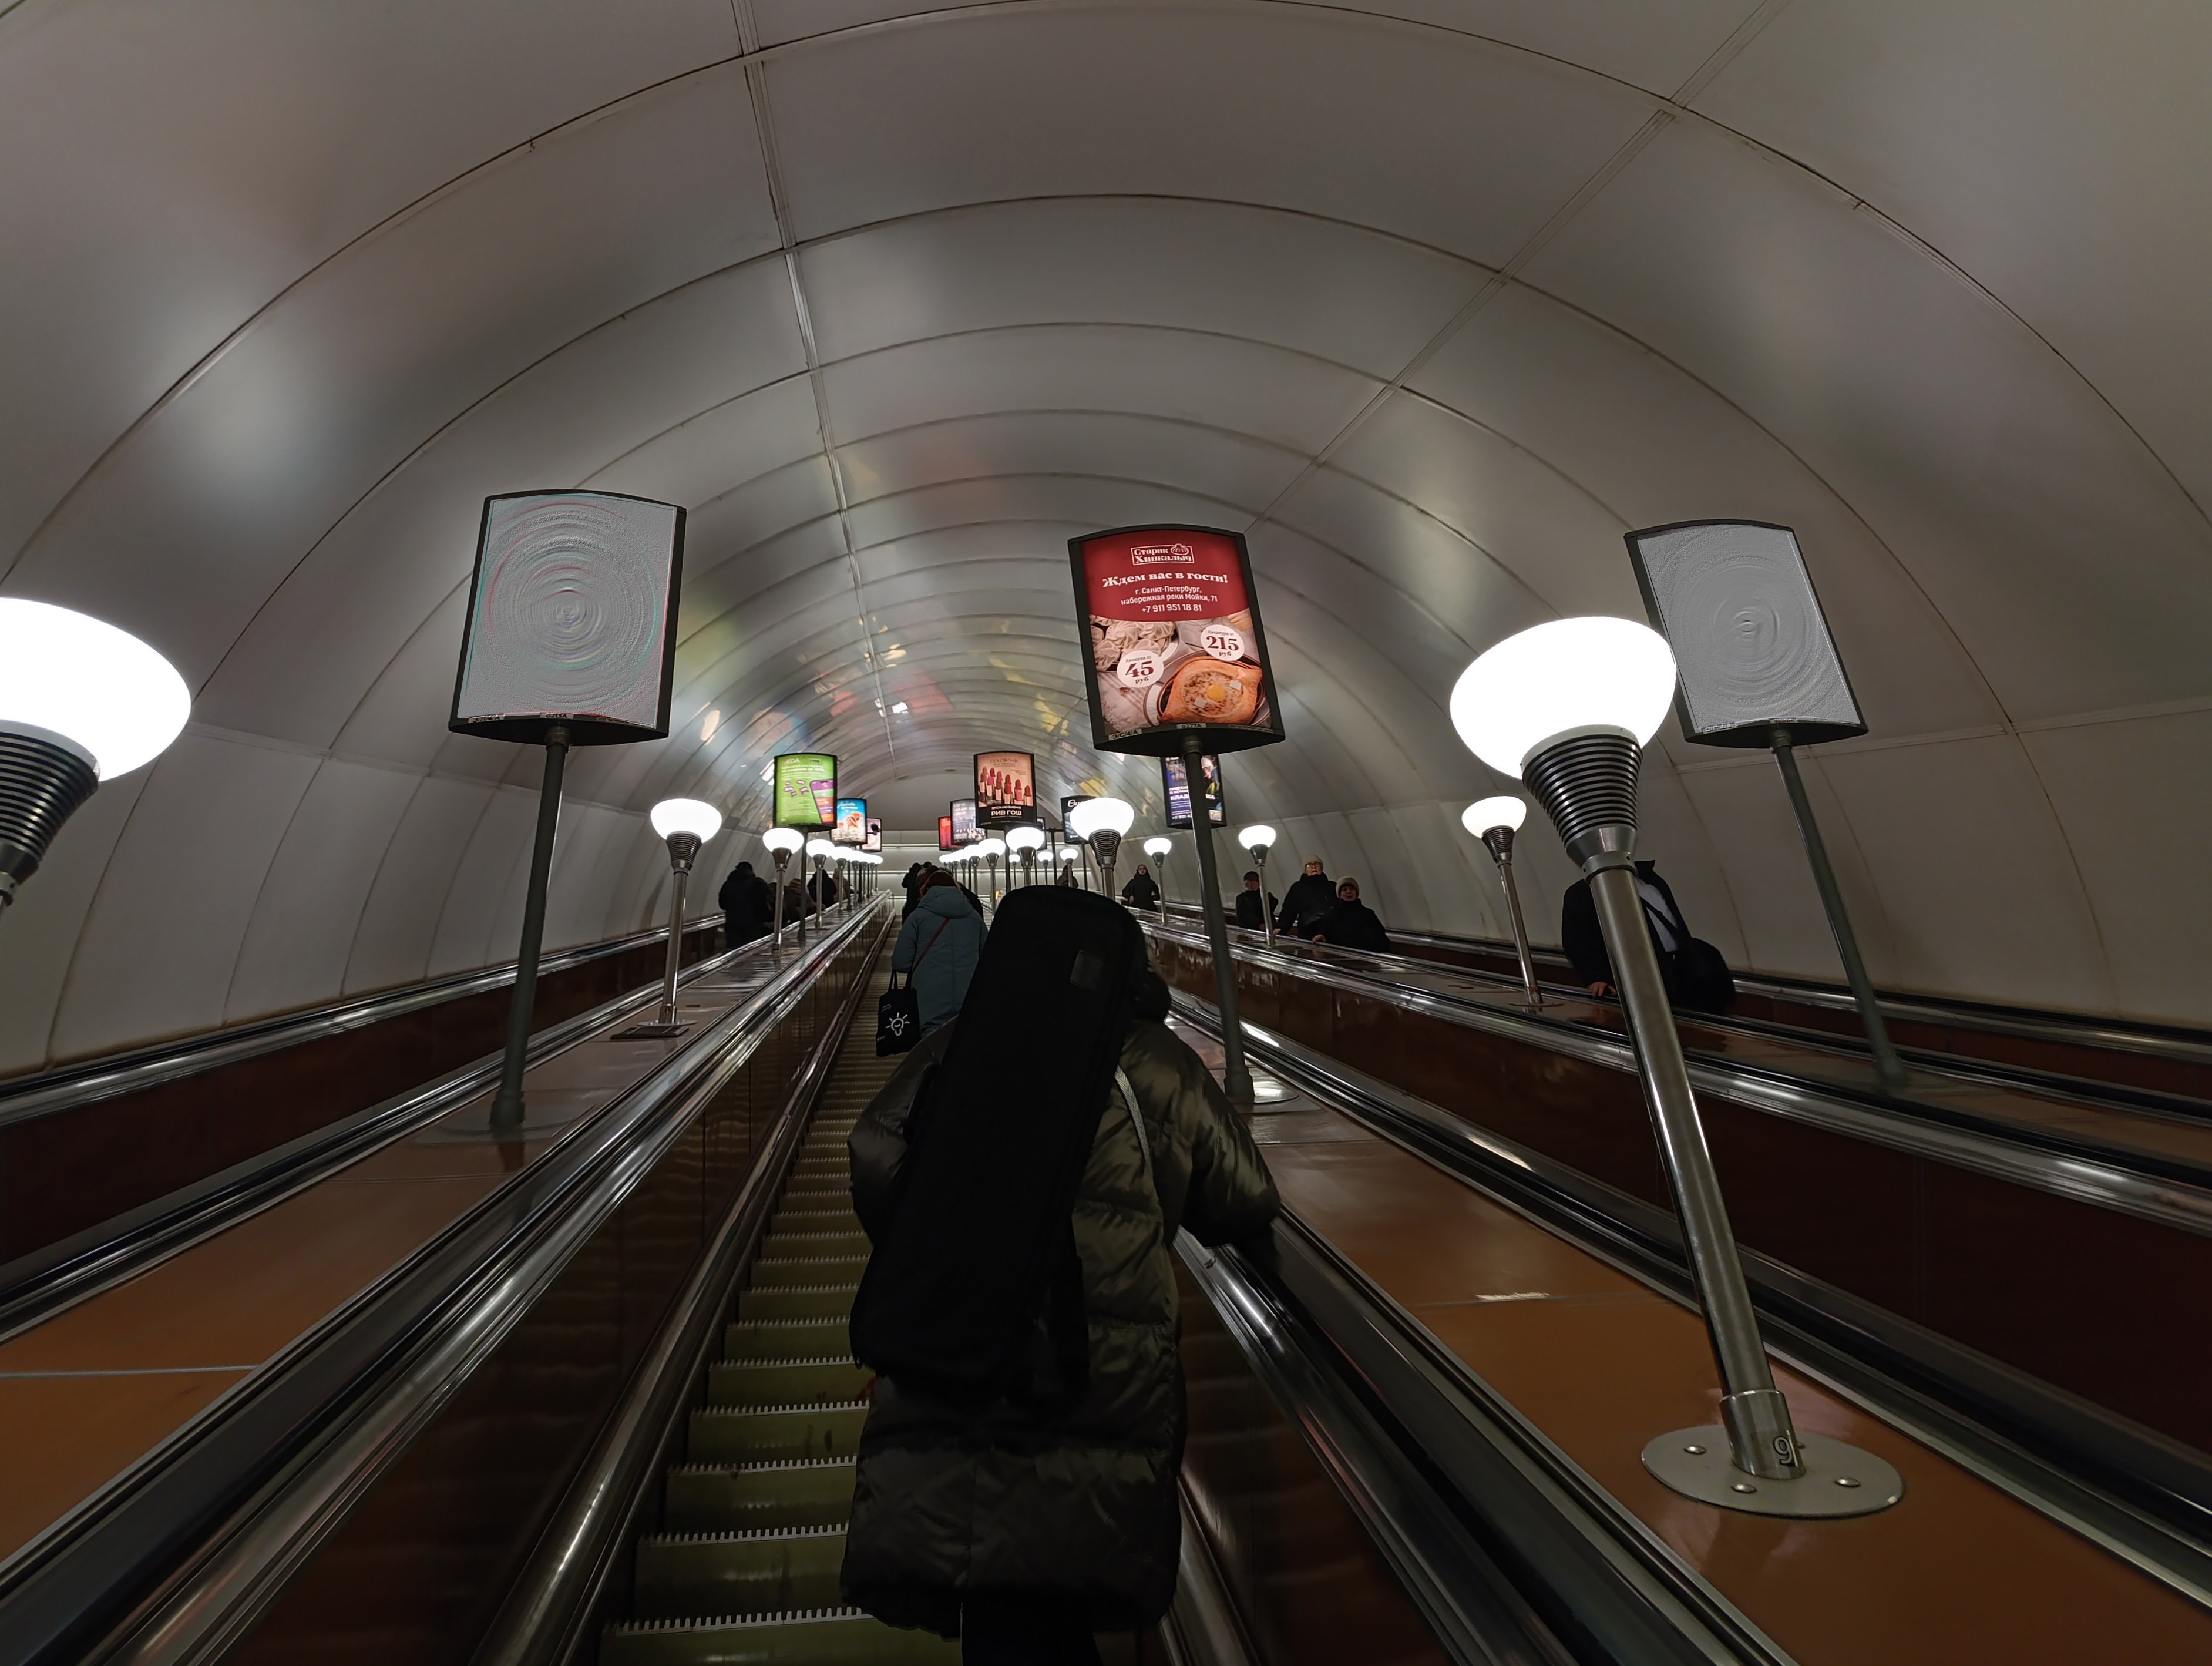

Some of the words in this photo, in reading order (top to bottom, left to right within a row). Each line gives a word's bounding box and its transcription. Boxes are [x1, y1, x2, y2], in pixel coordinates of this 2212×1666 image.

[1134, 548, 1169, 556] Старик
[1135, 555, 1192, 563] Хинкалыч
[1102, 575, 1146, 587] Ждем
[1187, 573, 1228, 583] гости!
[1121, 594, 1165, 606] набережная
[1206, 636, 1239, 651] 215
[1125, 660, 1154, 678] 45
[1773, 1436, 1793, 1465] 9
